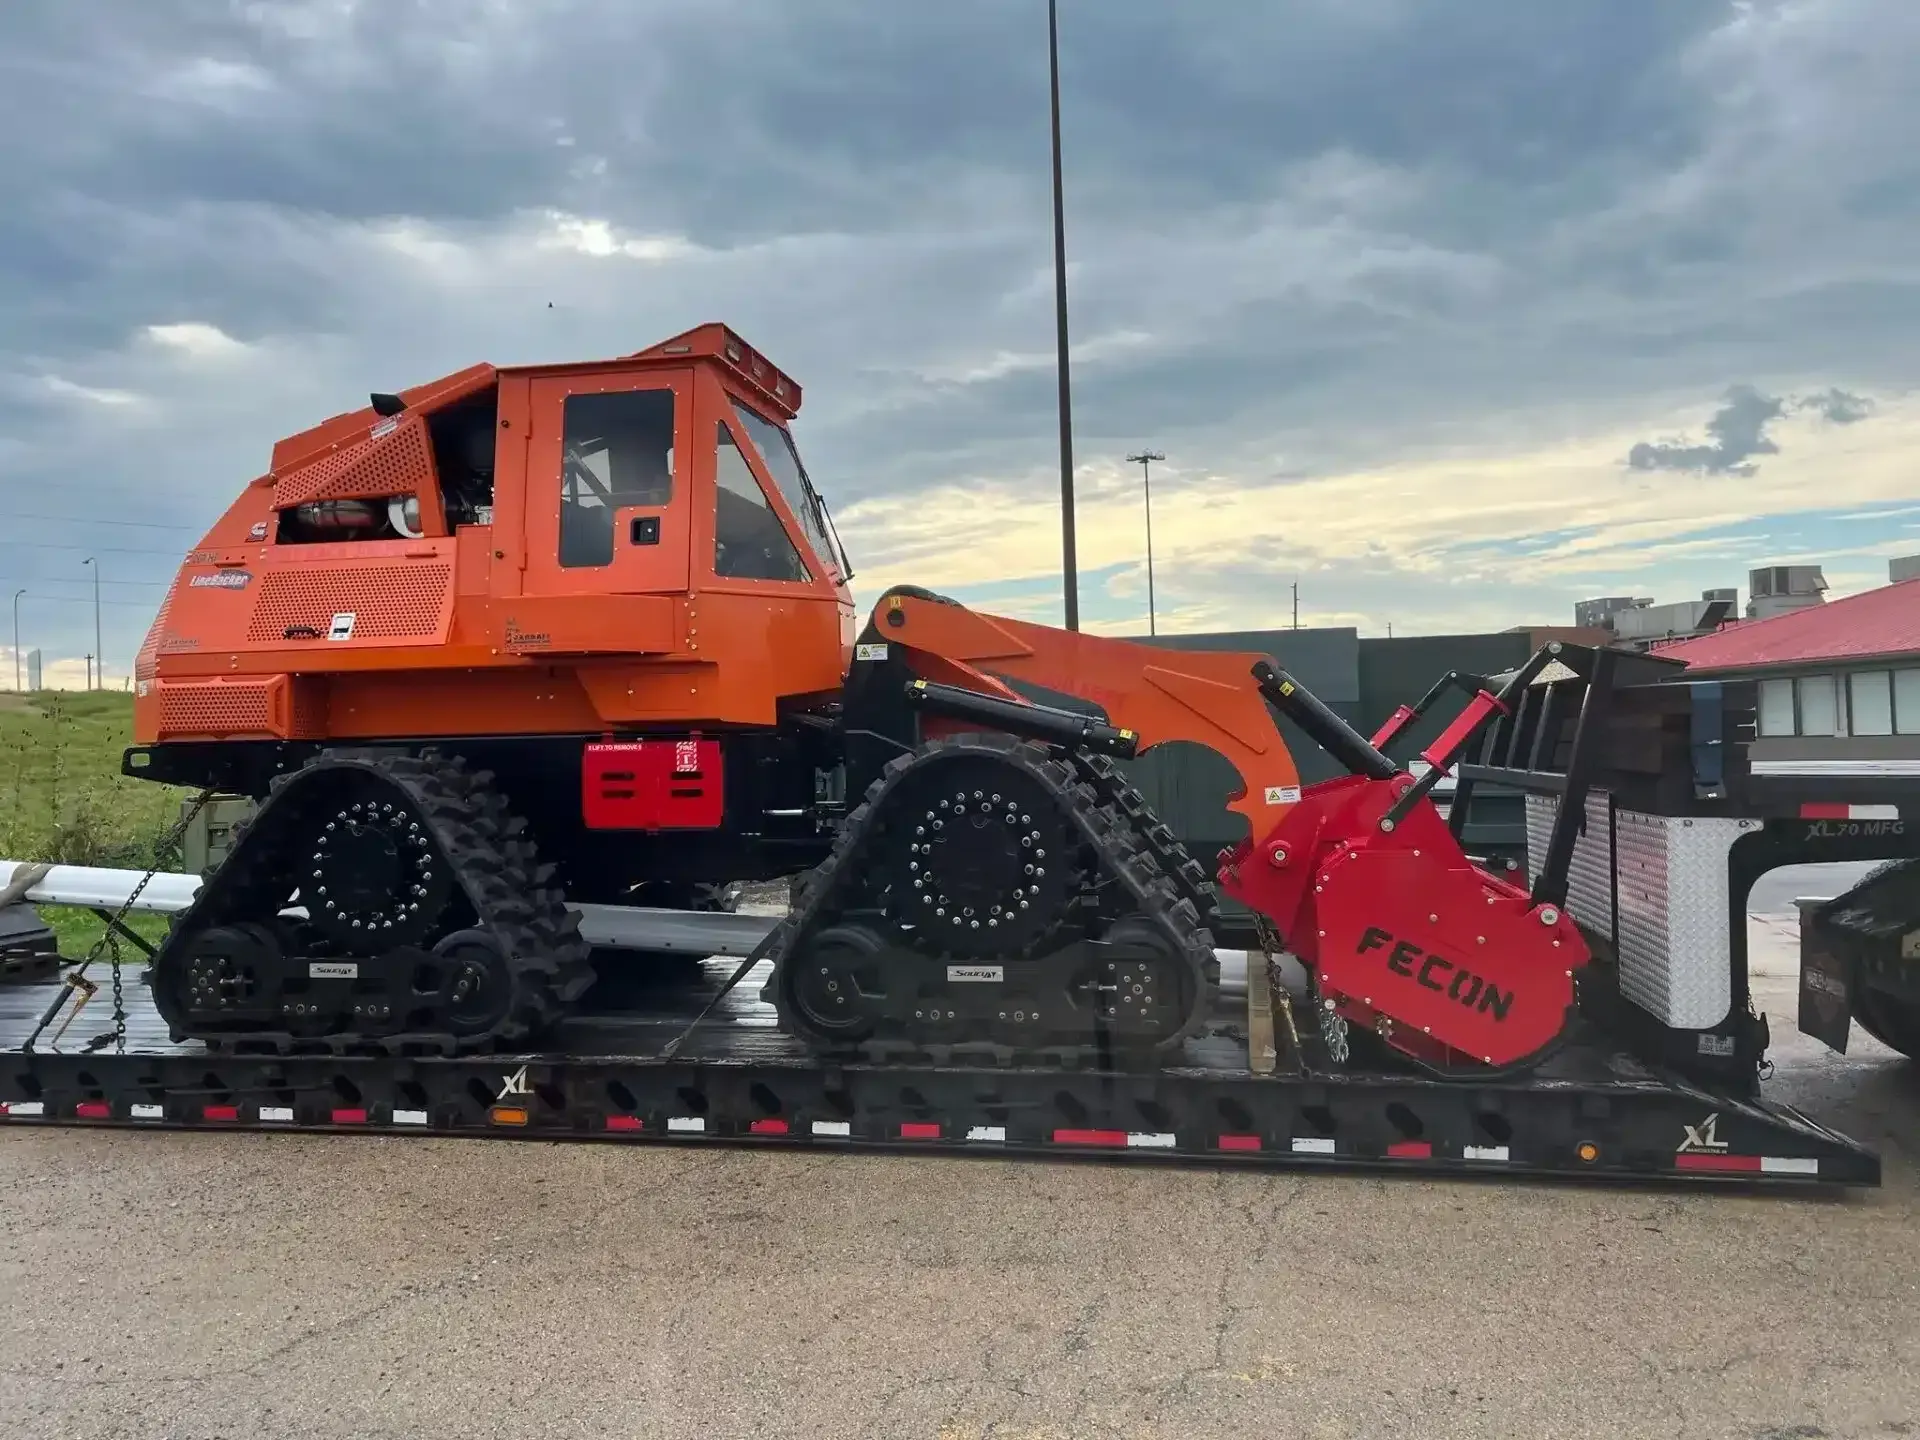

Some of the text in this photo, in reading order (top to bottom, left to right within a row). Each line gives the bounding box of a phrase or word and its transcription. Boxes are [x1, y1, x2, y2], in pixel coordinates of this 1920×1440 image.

[1863, 821, 1904, 836] MFG
[1356, 926, 1515, 1022] FECON
[496, 1064, 536, 1100] XL
[1676, 1112, 1729, 1152] XL
